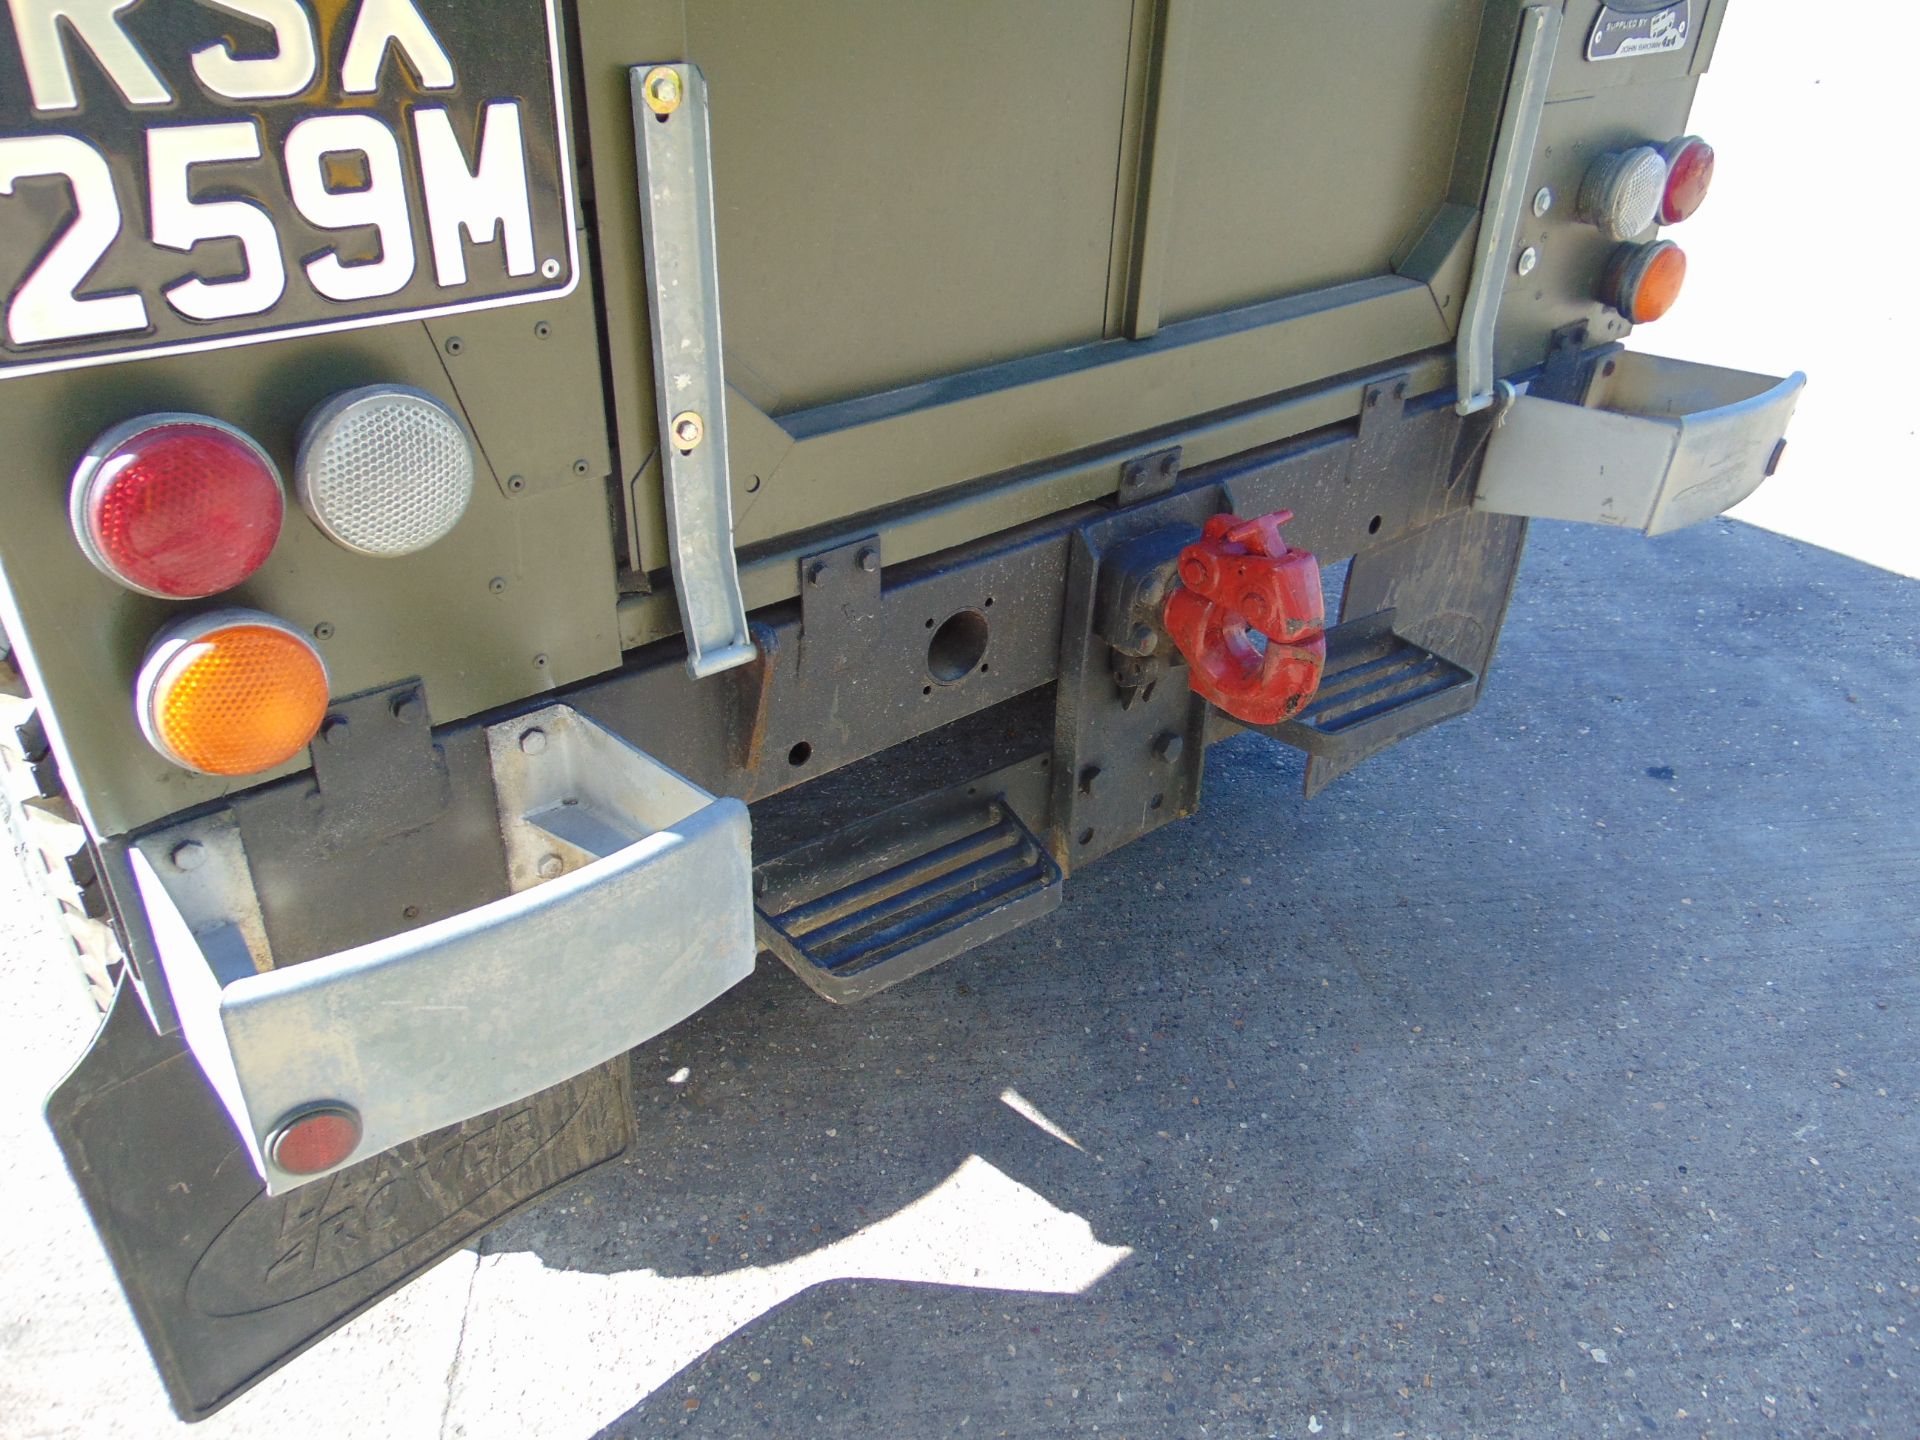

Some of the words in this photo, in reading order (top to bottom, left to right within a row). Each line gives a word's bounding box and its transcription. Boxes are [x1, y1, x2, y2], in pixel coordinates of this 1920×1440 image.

[1606, 20, 1637, 31] SUPPLIED
[1638, 18, 1648, 28] BY
[0, 101, 536, 345] 259M
